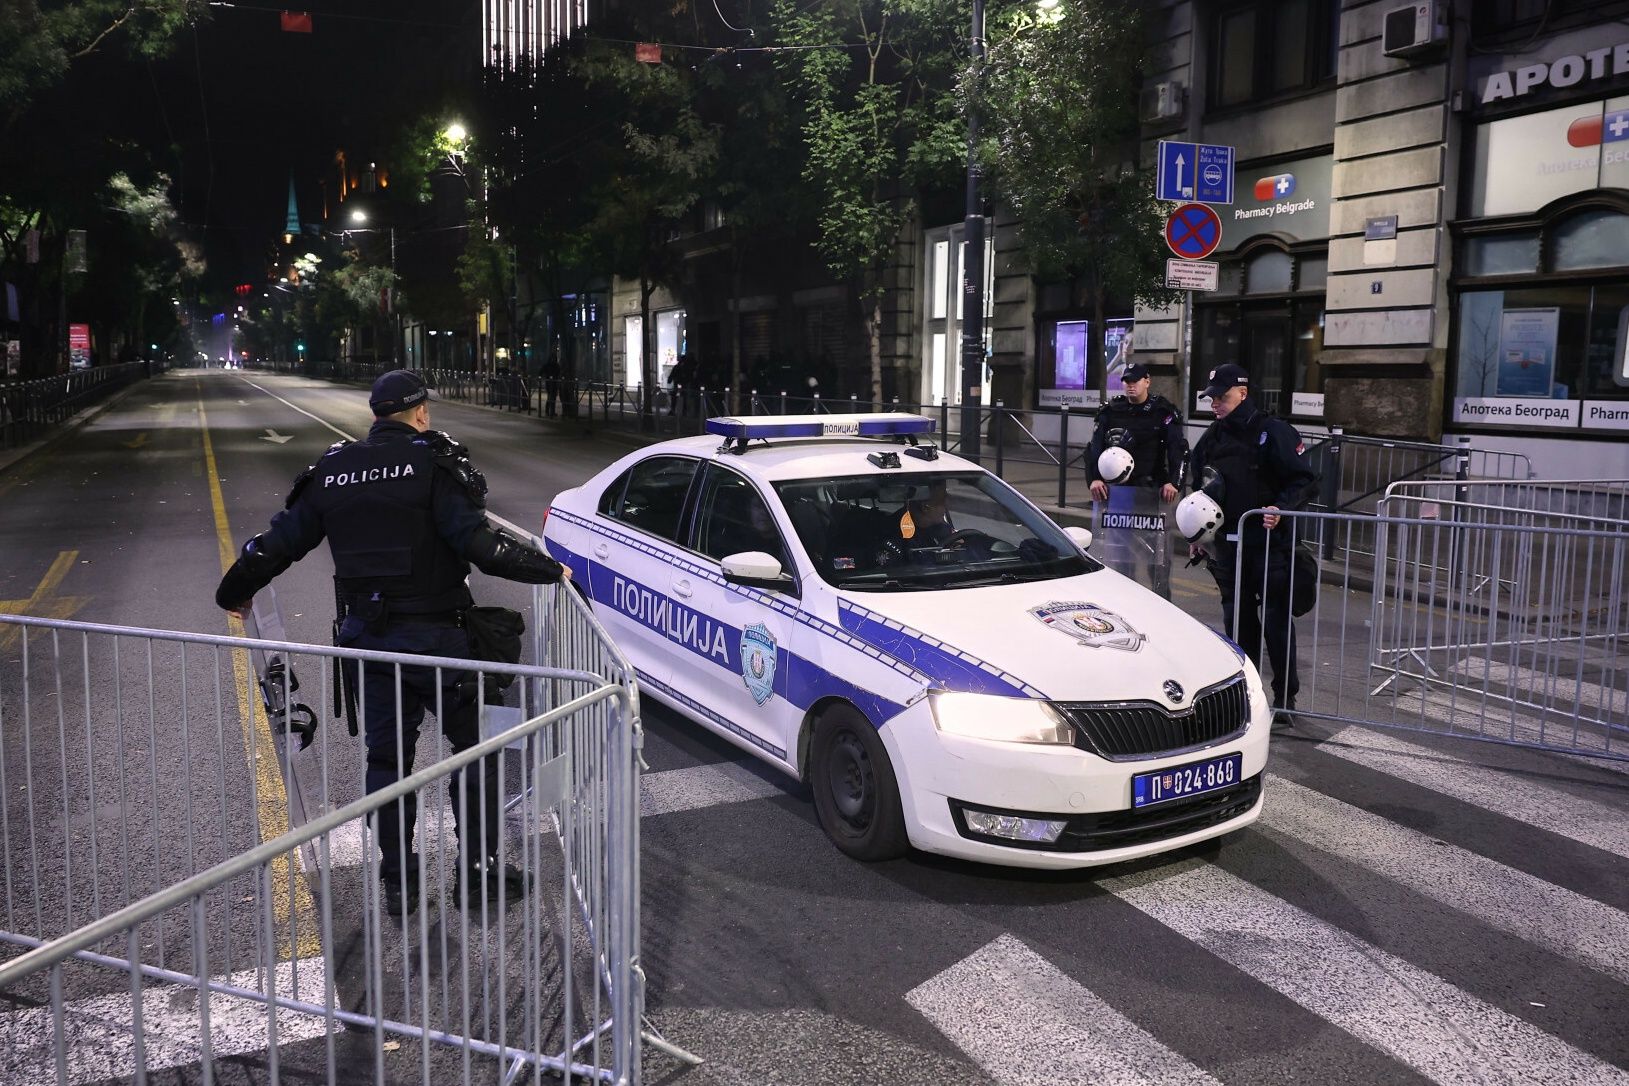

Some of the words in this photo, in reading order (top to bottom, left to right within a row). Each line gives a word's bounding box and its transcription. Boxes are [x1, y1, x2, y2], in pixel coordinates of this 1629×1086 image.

[1234, 206, 1275, 220] Pharmacy
[1276, 198, 1315, 215] Belgrade
[1461, 403, 1512, 416] Апотека
[1515, 404, 1570, 420] Београд
[824, 424, 858, 434] ПОЛИЦИЈА
[324, 463, 415, 488] POLICIJA
[1103, 514, 1164, 531] ПОЛИЦИЈА
[613, 576, 730, 665] ПОЛИЦИЈА
